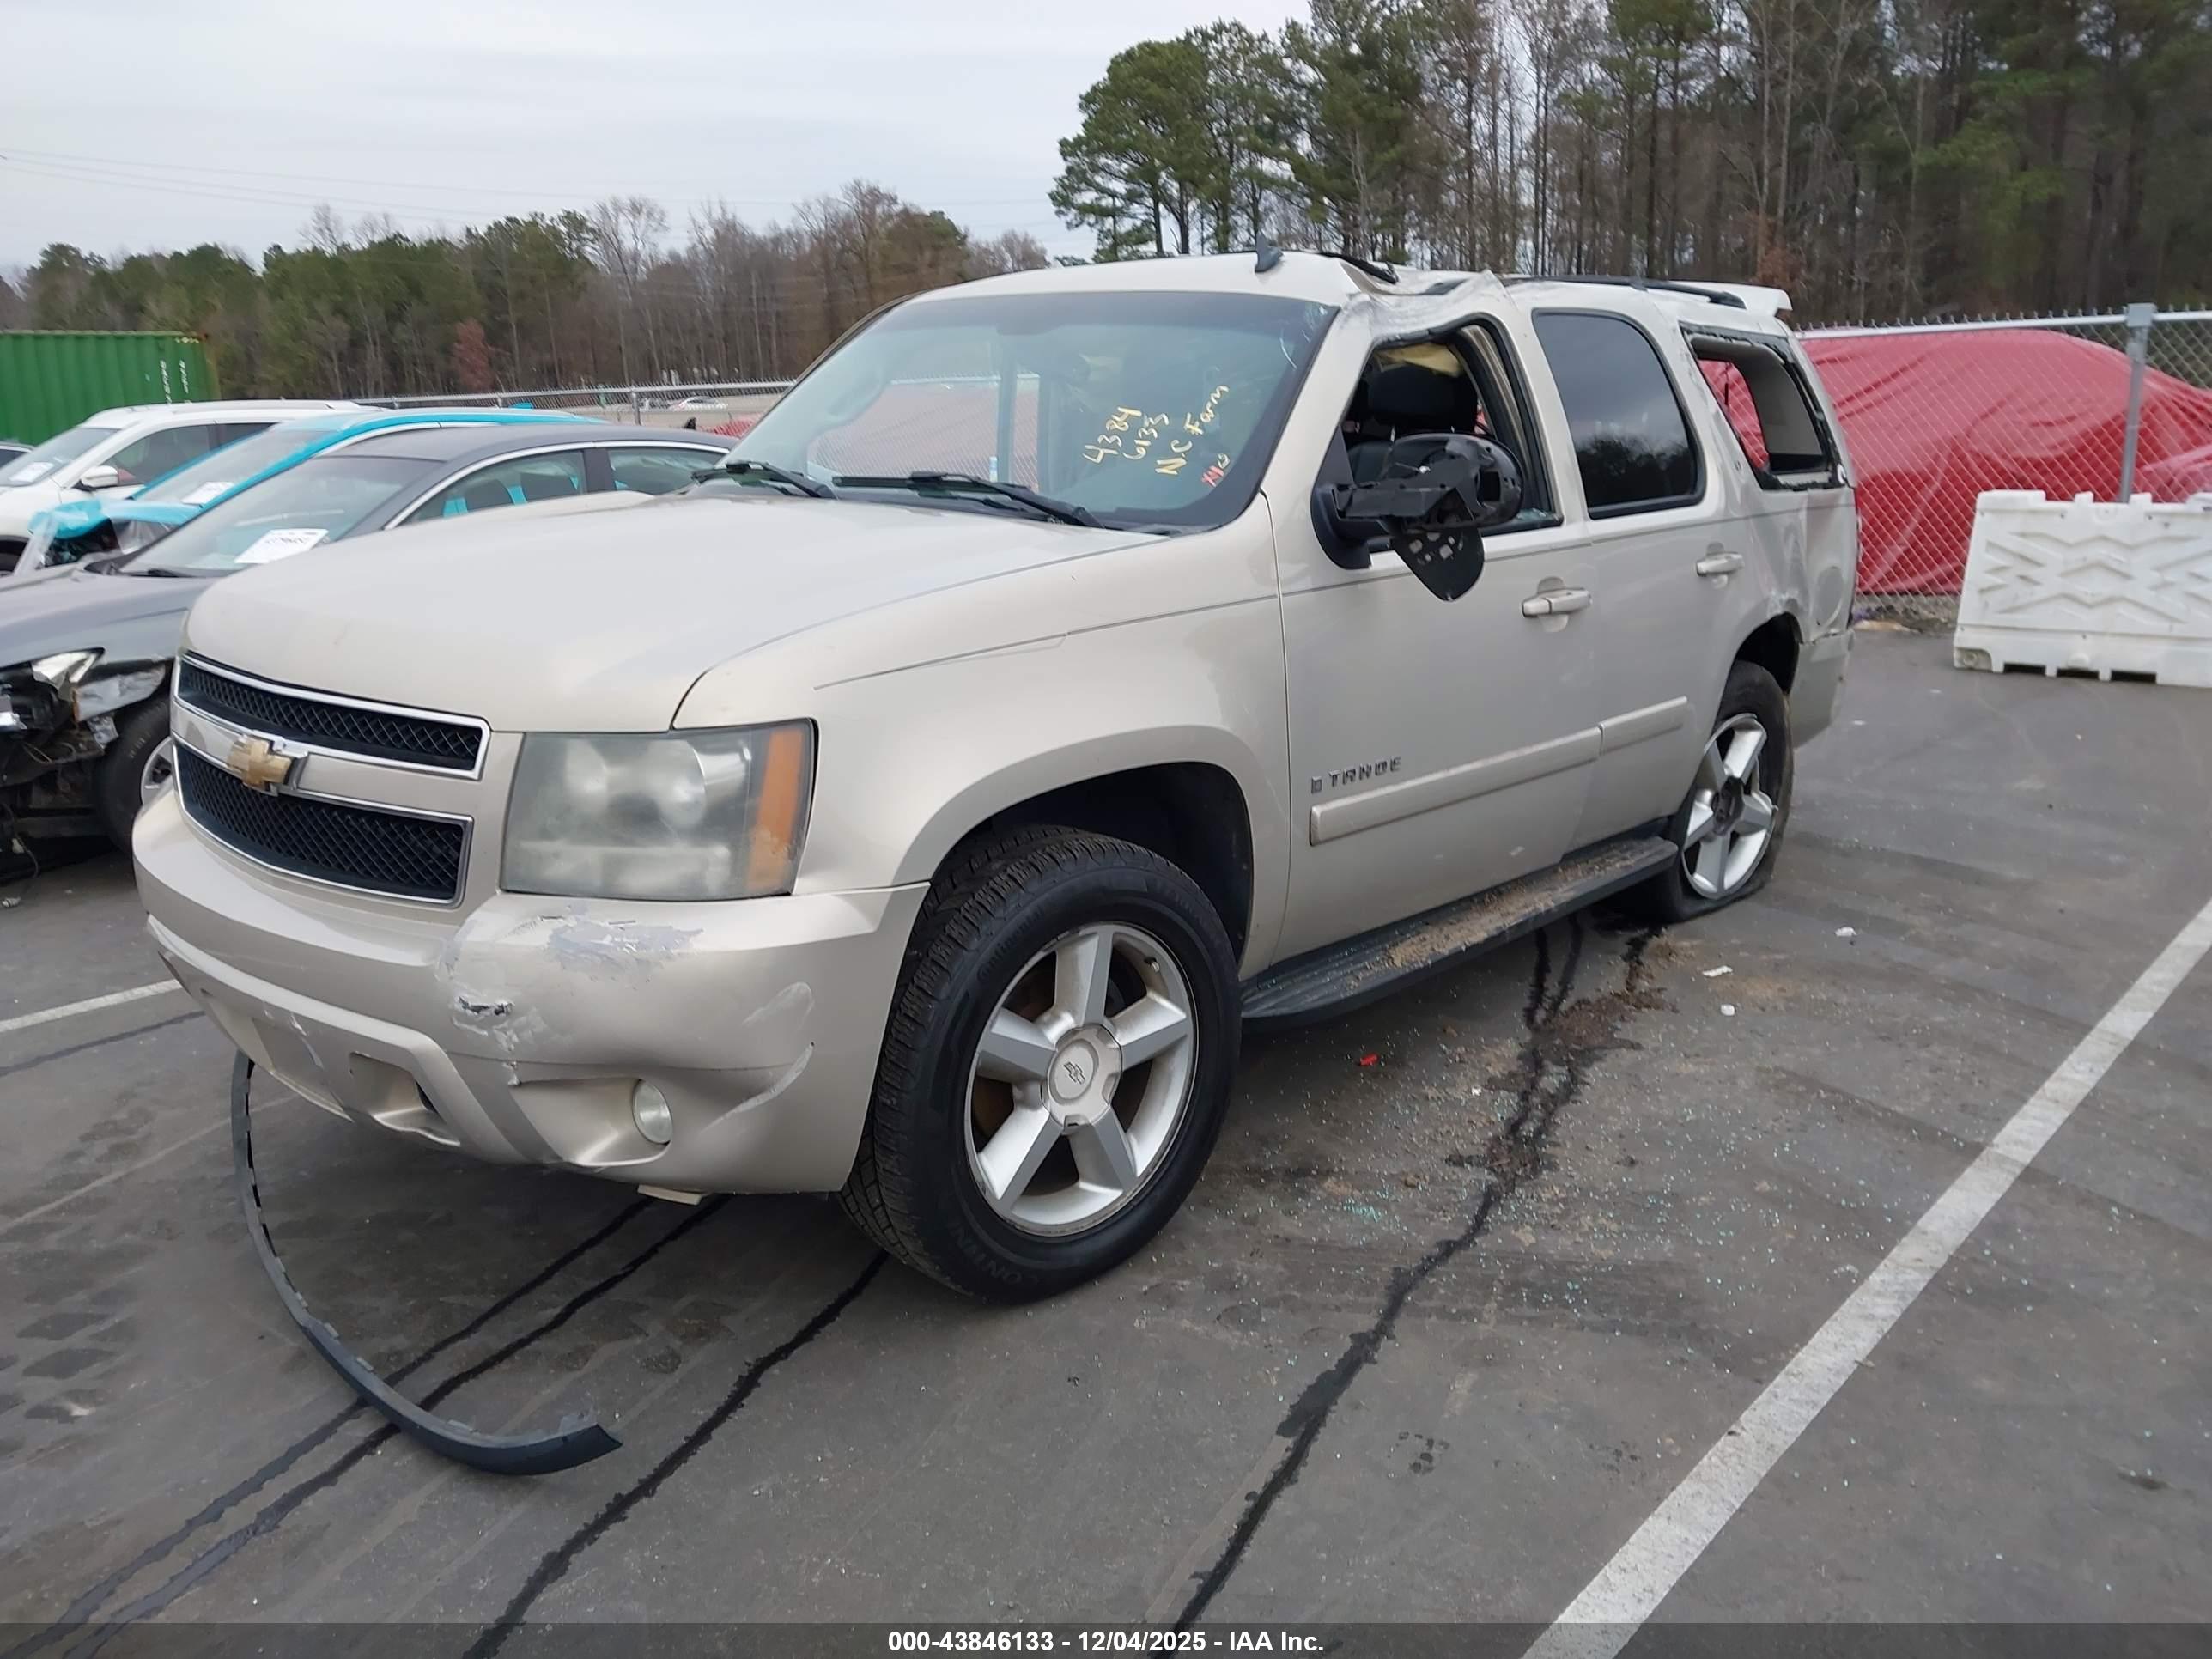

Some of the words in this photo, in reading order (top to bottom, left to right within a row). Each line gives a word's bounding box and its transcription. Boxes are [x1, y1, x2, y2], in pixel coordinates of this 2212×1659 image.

[1082, 406, 1142, 464] 4384
[1184, 386, 1229, 435] Farm
[1328, 757, 1401, 787] TAHOE
